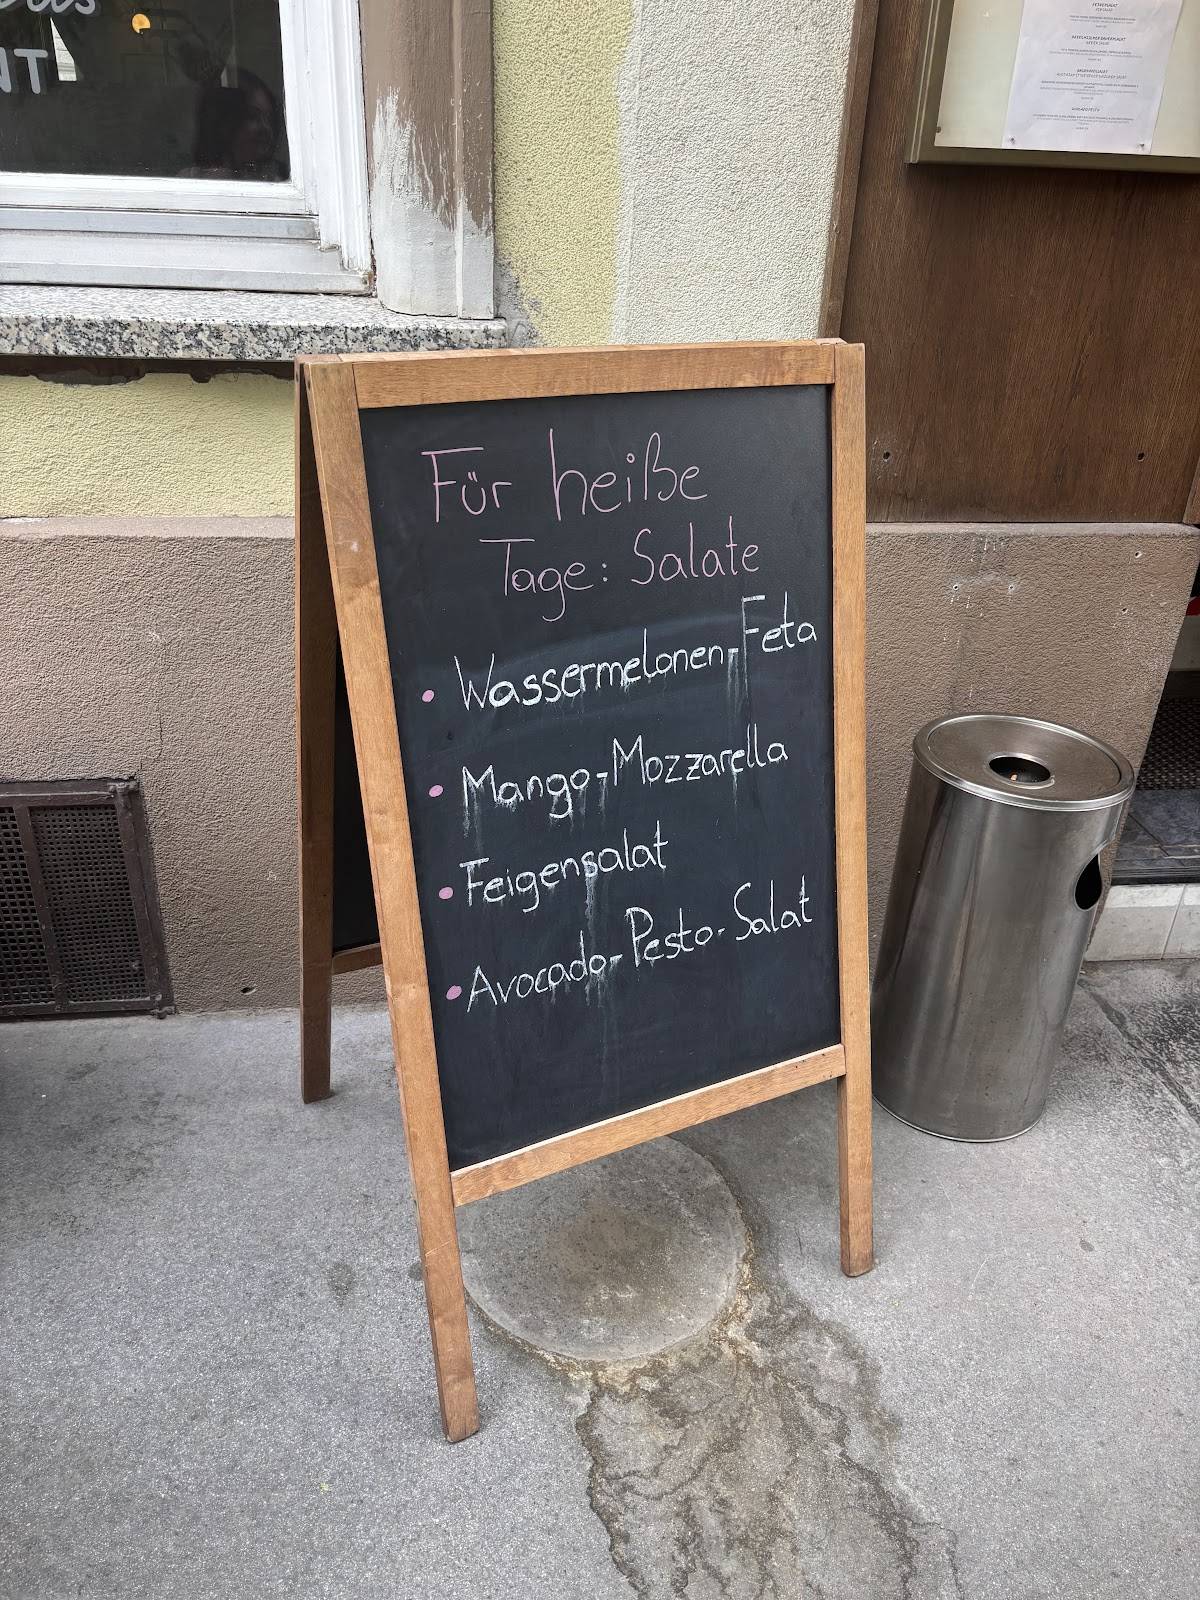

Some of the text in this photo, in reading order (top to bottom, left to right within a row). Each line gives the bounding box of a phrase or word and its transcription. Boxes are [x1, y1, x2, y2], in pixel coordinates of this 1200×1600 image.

[421, 428, 708, 523] Für heiße
[479, 515, 760, 622] Tage: Salate
[454, 591, 818, 712] Wassermelonen-Feta
[461, 723, 790, 819] Mango-Mozzarella
[459, 820, 669, 913] Feigensalat
